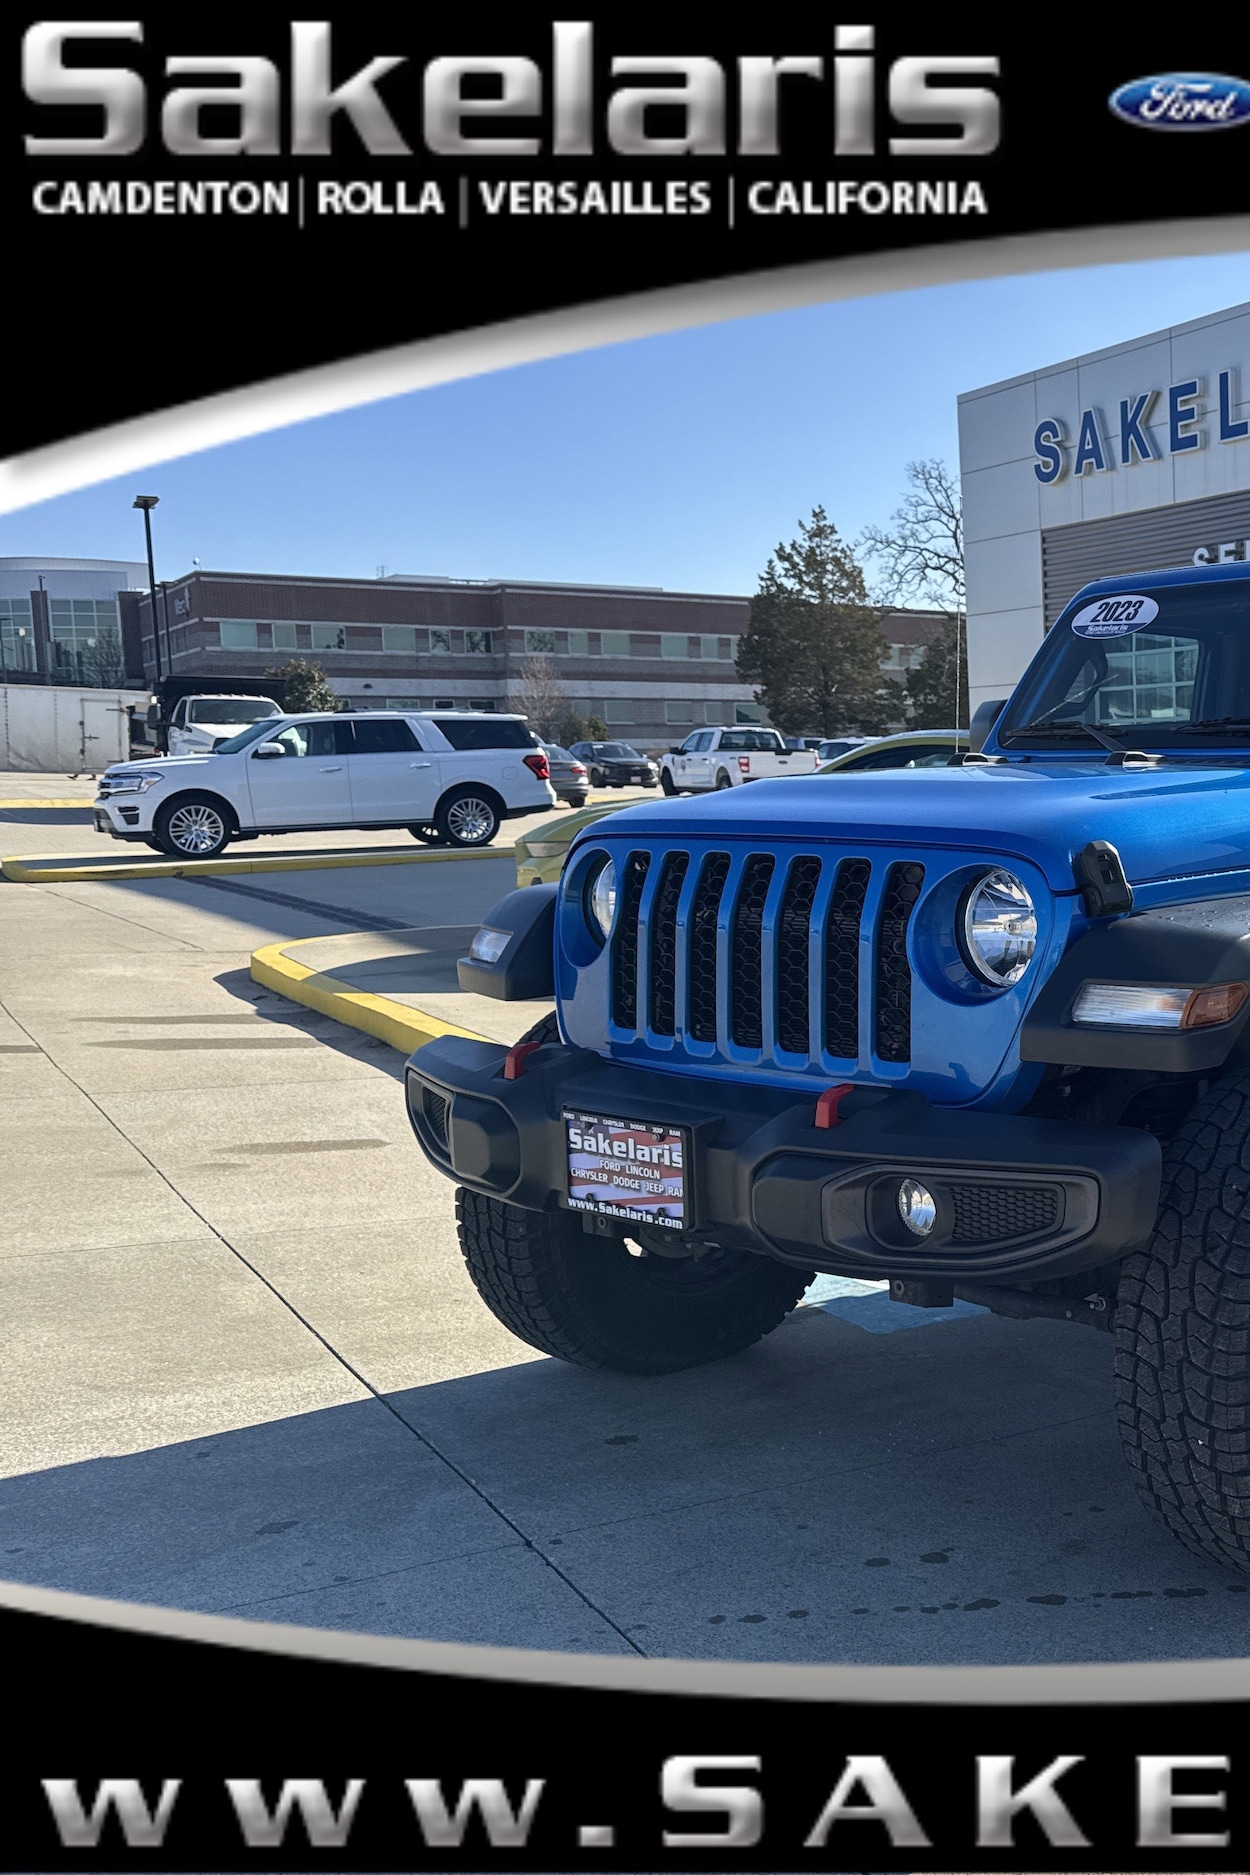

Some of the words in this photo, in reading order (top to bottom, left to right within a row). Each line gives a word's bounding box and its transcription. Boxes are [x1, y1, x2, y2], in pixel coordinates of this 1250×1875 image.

[1090, 600, 1145, 623] 2023
[1087, 624, 1129, 632] Sakelaris
[563, 1112, 575, 1120] FORD
[580, 1115, 598, 1124] LINCOLN
[602, 1118, 625, 1128] CHRYSLER
[630, 1123, 647, 1131] DODGE
[652, 1126, 664, 1134] JEEP
[669, 1129, 681, 1137] RAM
[568, 1128, 683, 1168] Sakelaris
[571, 1168, 608, 1183] CHRYSLER
[613, 1175, 641, 1190] DODGE
[645, 1181, 664, 1194] JEEP
[599, 1159, 621, 1172] FORD
[625, 1165, 661, 1180] LINCOLN
